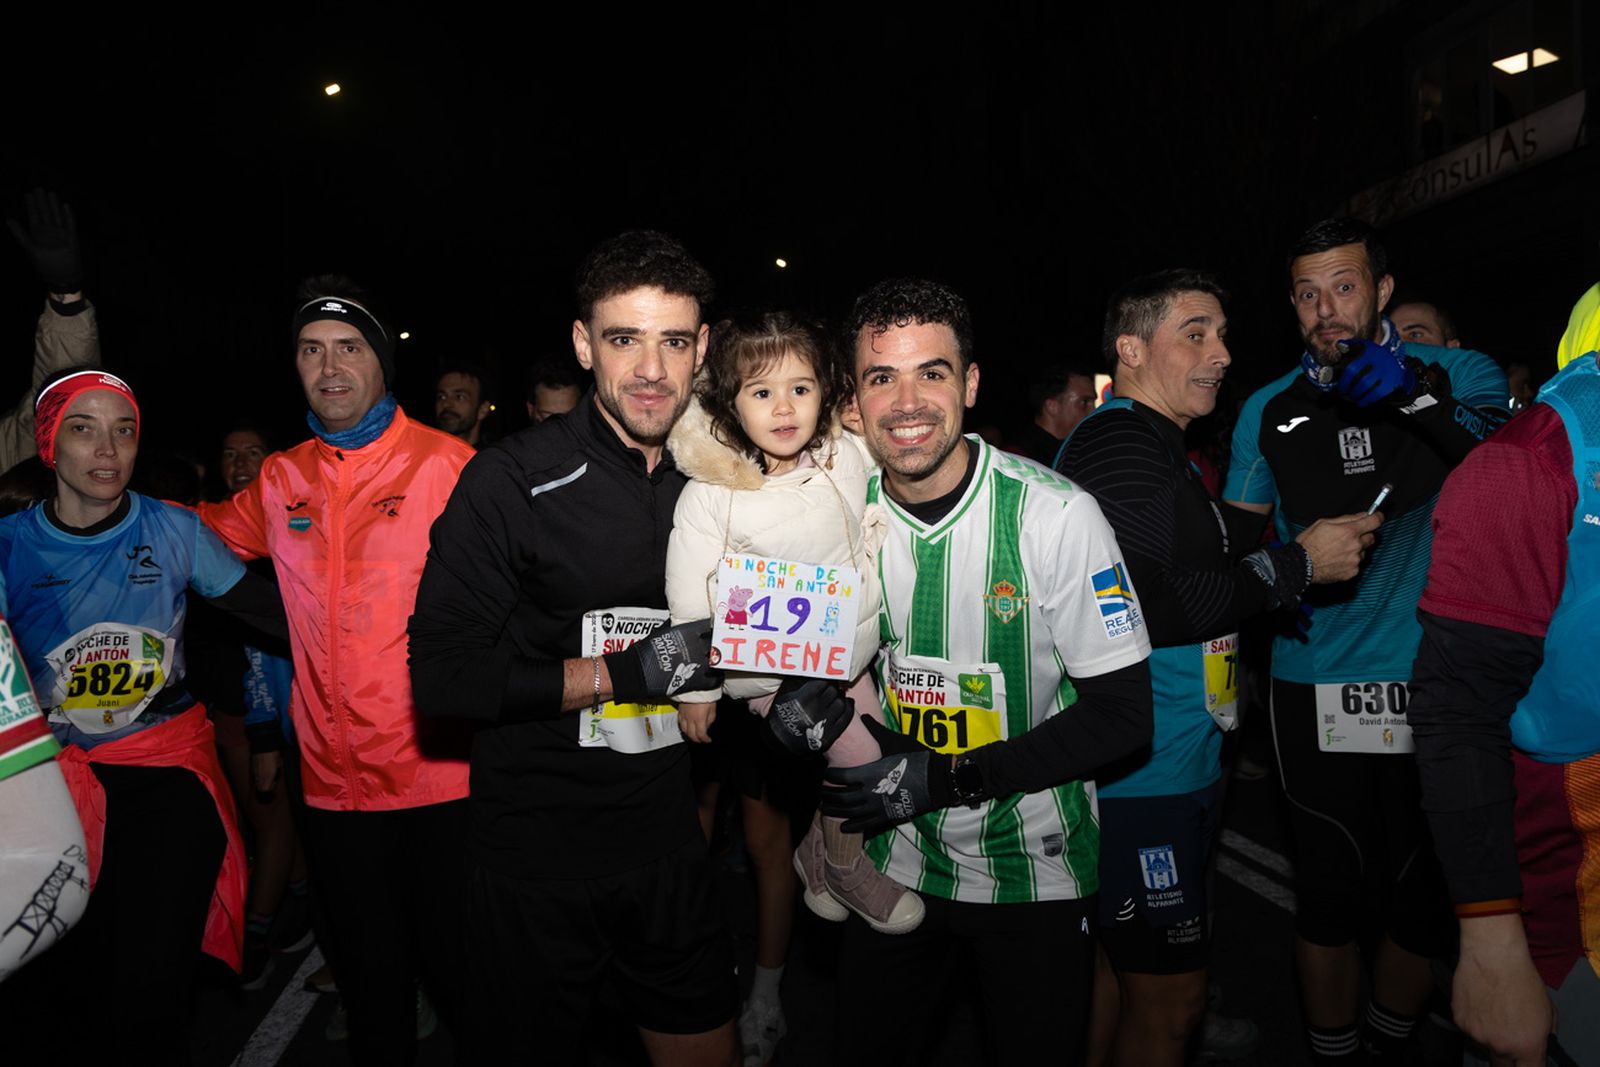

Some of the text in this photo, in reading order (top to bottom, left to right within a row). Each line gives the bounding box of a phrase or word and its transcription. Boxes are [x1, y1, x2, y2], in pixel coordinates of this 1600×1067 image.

[745, 559, 796, 577] NOCHE
[816, 567, 837, 581] DE
[758, 575, 851, 598] SAN ANTÓN
[749, 595, 811, 635] 19
[1105, 608, 1139, 630] REALE
[113, 635, 129, 646] DE
[661, 633, 677, 655] SAN
[1211, 639, 1230, 653] SAN
[85, 647, 129, 663] ANTÓN
[652, 637, 672, 672] ANTÓN
[722, 637, 847, 676] IRENE
[67, 662, 155, 698] 5824
[671, 674, 683, 688] 43
[896, 671, 945, 687] CHE DE
[96, 699, 119, 707] Juani
[897, 688, 945, 706] ANTÓN
[1359, 717, 1381, 725] David
[900, 788, 915, 816] NTÓN
